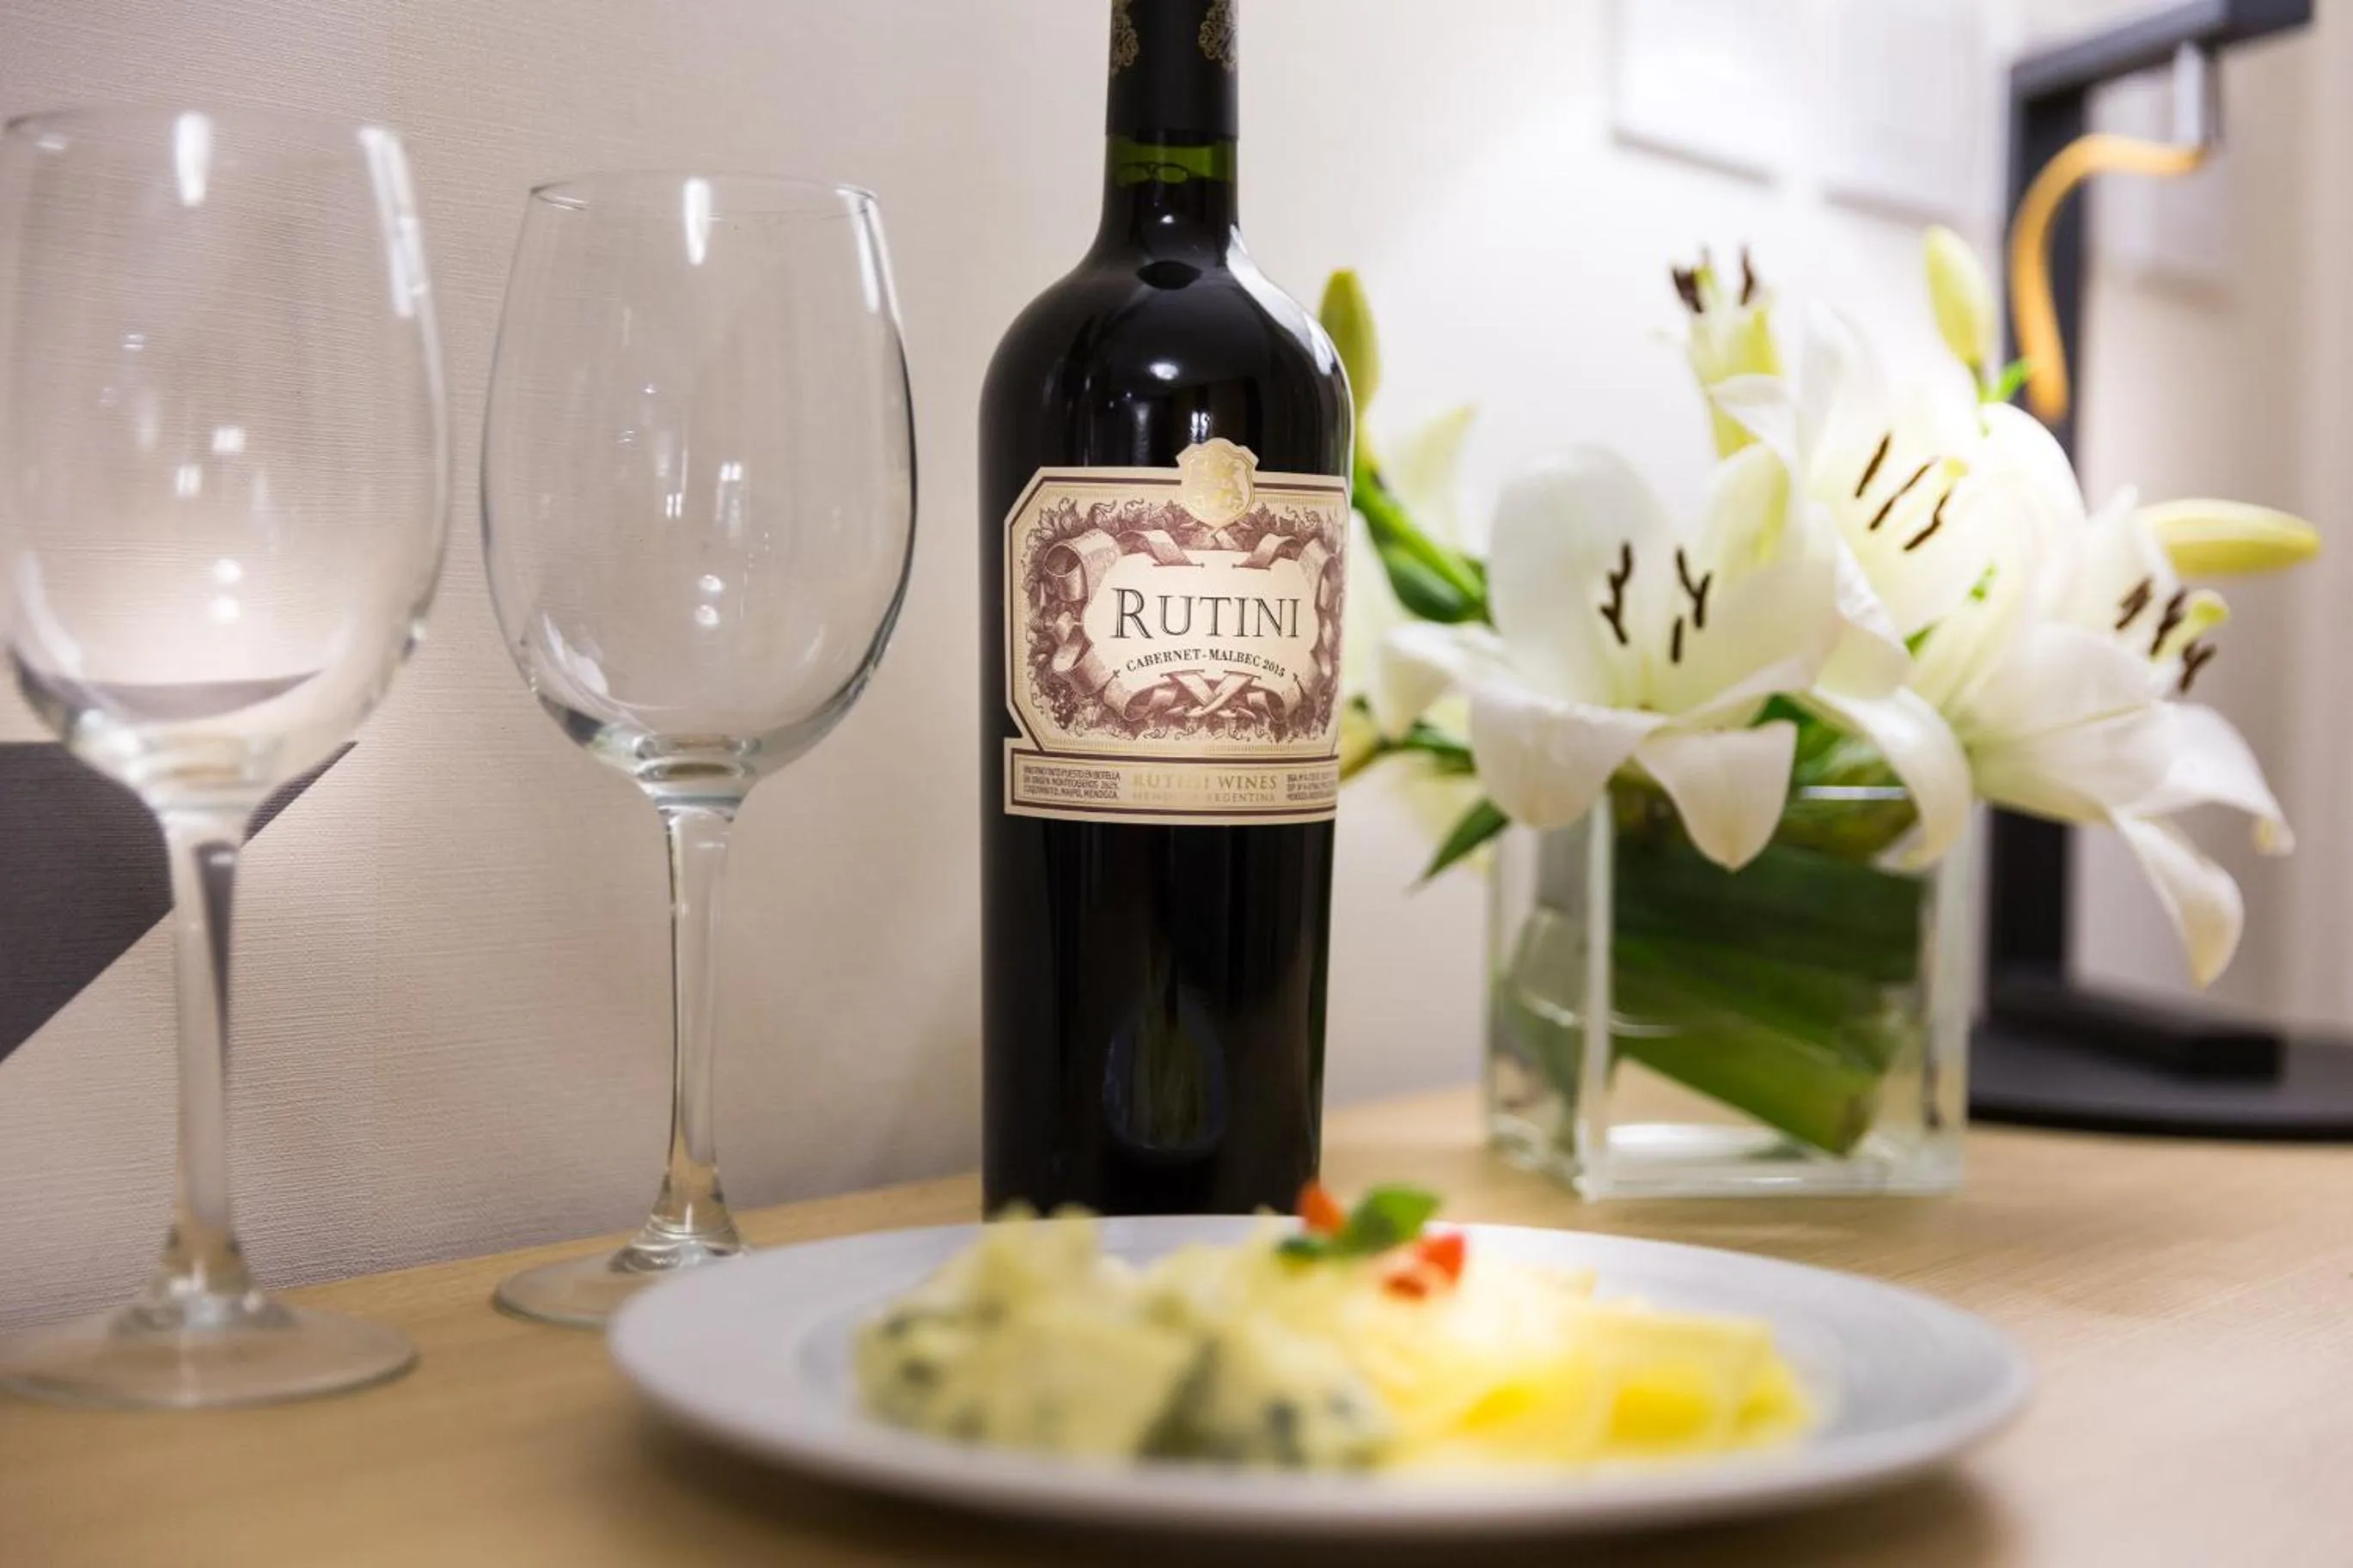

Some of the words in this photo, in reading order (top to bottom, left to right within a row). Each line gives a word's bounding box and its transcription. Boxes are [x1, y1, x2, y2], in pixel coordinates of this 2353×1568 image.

[1109, 588, 1301, 639] RUTINI
[1133, 774, 1209, 790] RUTII
[1217, 775, 1277, 790] WINES
